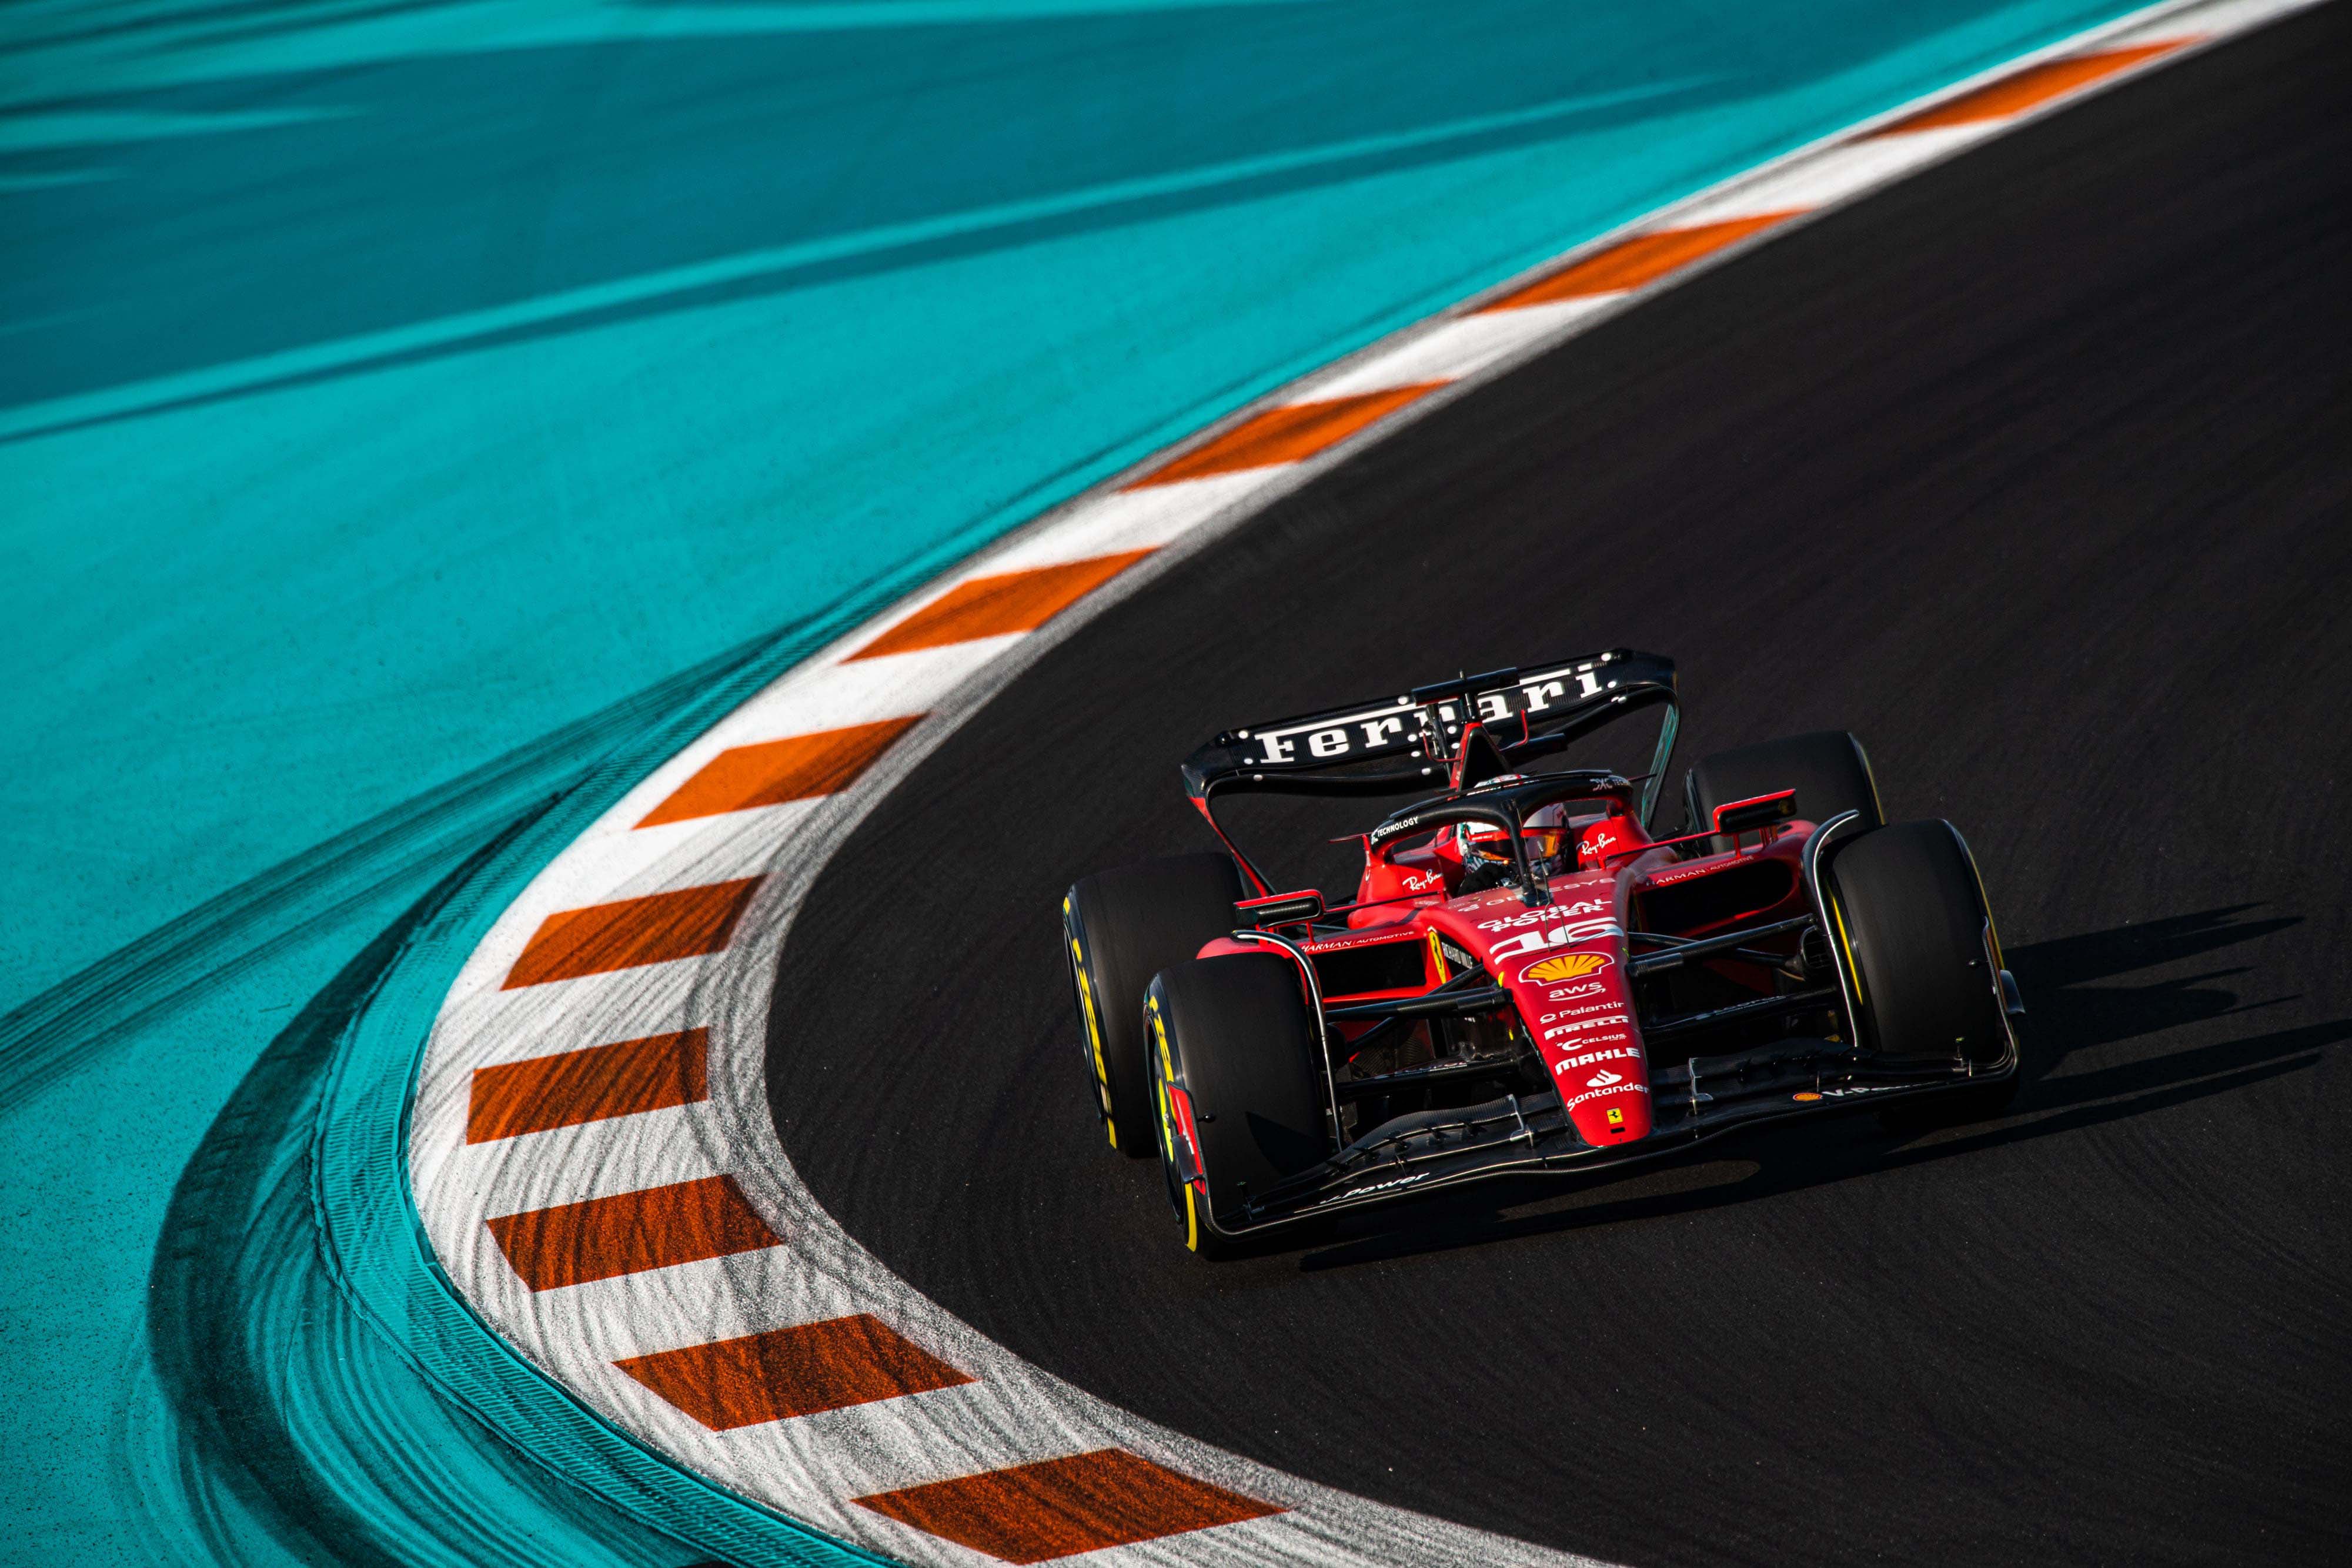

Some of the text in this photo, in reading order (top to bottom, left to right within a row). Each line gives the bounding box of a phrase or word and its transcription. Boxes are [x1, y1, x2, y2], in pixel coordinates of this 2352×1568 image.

[1254, 662, 1602, 764] Ferrari
[1378, 816, 1419, 837] TECHNOLOGY
[1576, 833, 1616, 856] Ray-Ban
[1402, 868, 1444, 891] Ray-Ban
[1477, 898, 1612, 930] GLOBAL
[1491, 905, 1604, 932] POKER
[1301, 931, 1415, 952] HARMAN AUTOMOTIVE
[1489, 916, 1625, 965] 16
[1549, 982, 1603, 998] aws
[1559, 1001, 1626, 1018] Palantir
[1544, 1015, 1629, 1040] PIRELLI
[1582, 1034, 1626, 1044] CELSIUS
[1555, 1047, 1641, 1075] MAHLE
[1566, 1082, 1649, 1112] Santander
